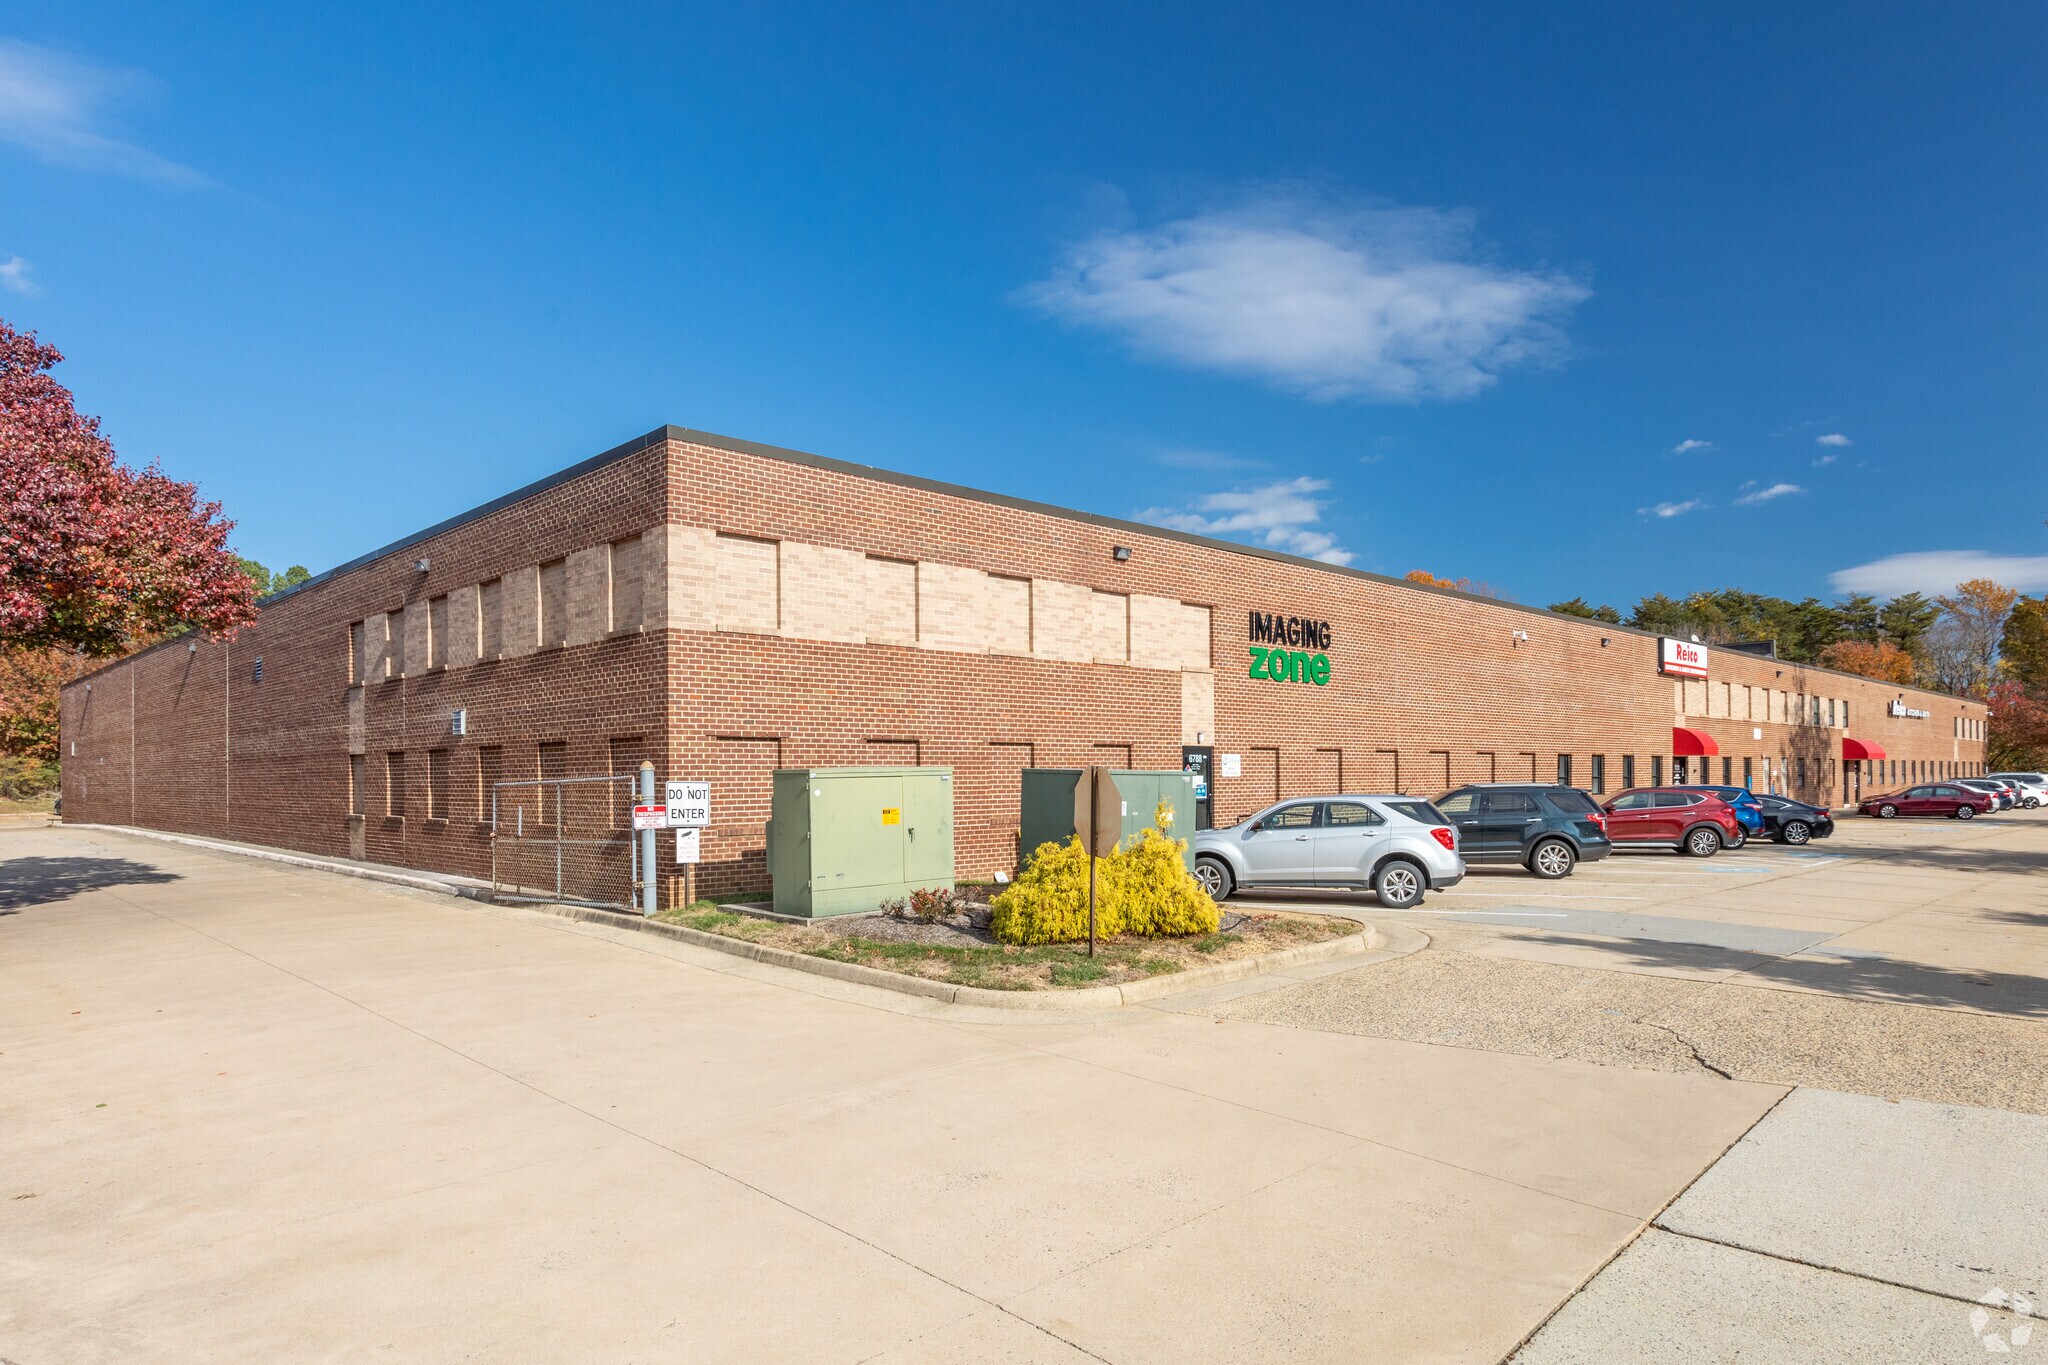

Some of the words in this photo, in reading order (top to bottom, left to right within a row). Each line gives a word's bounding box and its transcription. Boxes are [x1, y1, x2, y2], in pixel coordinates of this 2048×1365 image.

[1249, 611, 1331, 650] IMAGING
[1676, 643, 1699, 663] Reico
[668, 789, 682, 800] DO
[687, 789, 707, 800] NOT
[671, 808, 705, 819] ENTER
